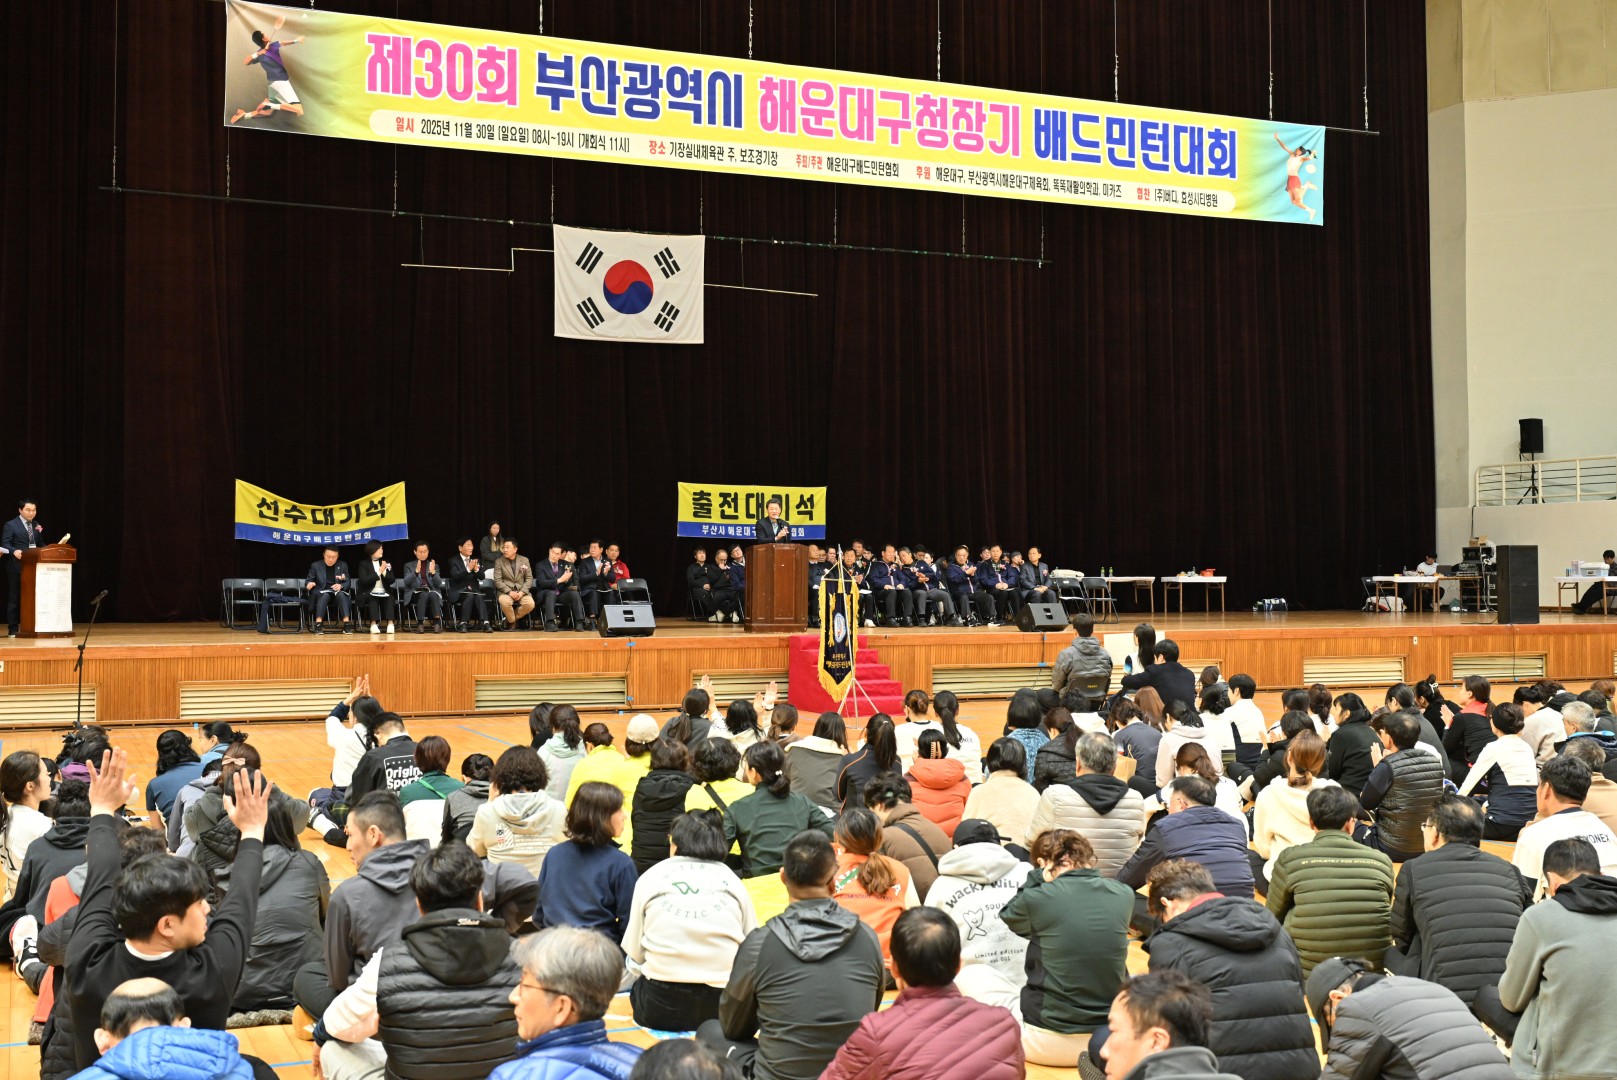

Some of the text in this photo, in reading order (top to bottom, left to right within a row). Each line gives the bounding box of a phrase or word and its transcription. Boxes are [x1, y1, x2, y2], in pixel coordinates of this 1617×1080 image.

[366, 33, 1237, 179] 제30회 부산광역시 해운대구청장기 배드민턴대회
[395, 116, 414, 133] 일시
[421, 119, 450, 137] 2025년
[454, 122, 473, 139] 11월
[476, 124, 495, 141] 30일
[532, 128, 574, 148] 08시~19시
[649, 140, 666, 155] 장소
[669, 141, 725, 162] 기장실내체육관
[740, 148, 778, 167] 보조경기장
[826, 156, 899, 177] 해운대구배드민턴협회
[916, 165, 931, 180] 후원
[1102, 183, 1122, 198] 미카즈
[256, 496, 386, 526] 선수대기석
[702, 524, 726, 536] 부산시
[386, 765, 423, 779] Origin
[660, 899, 708, 919] HLETIC
